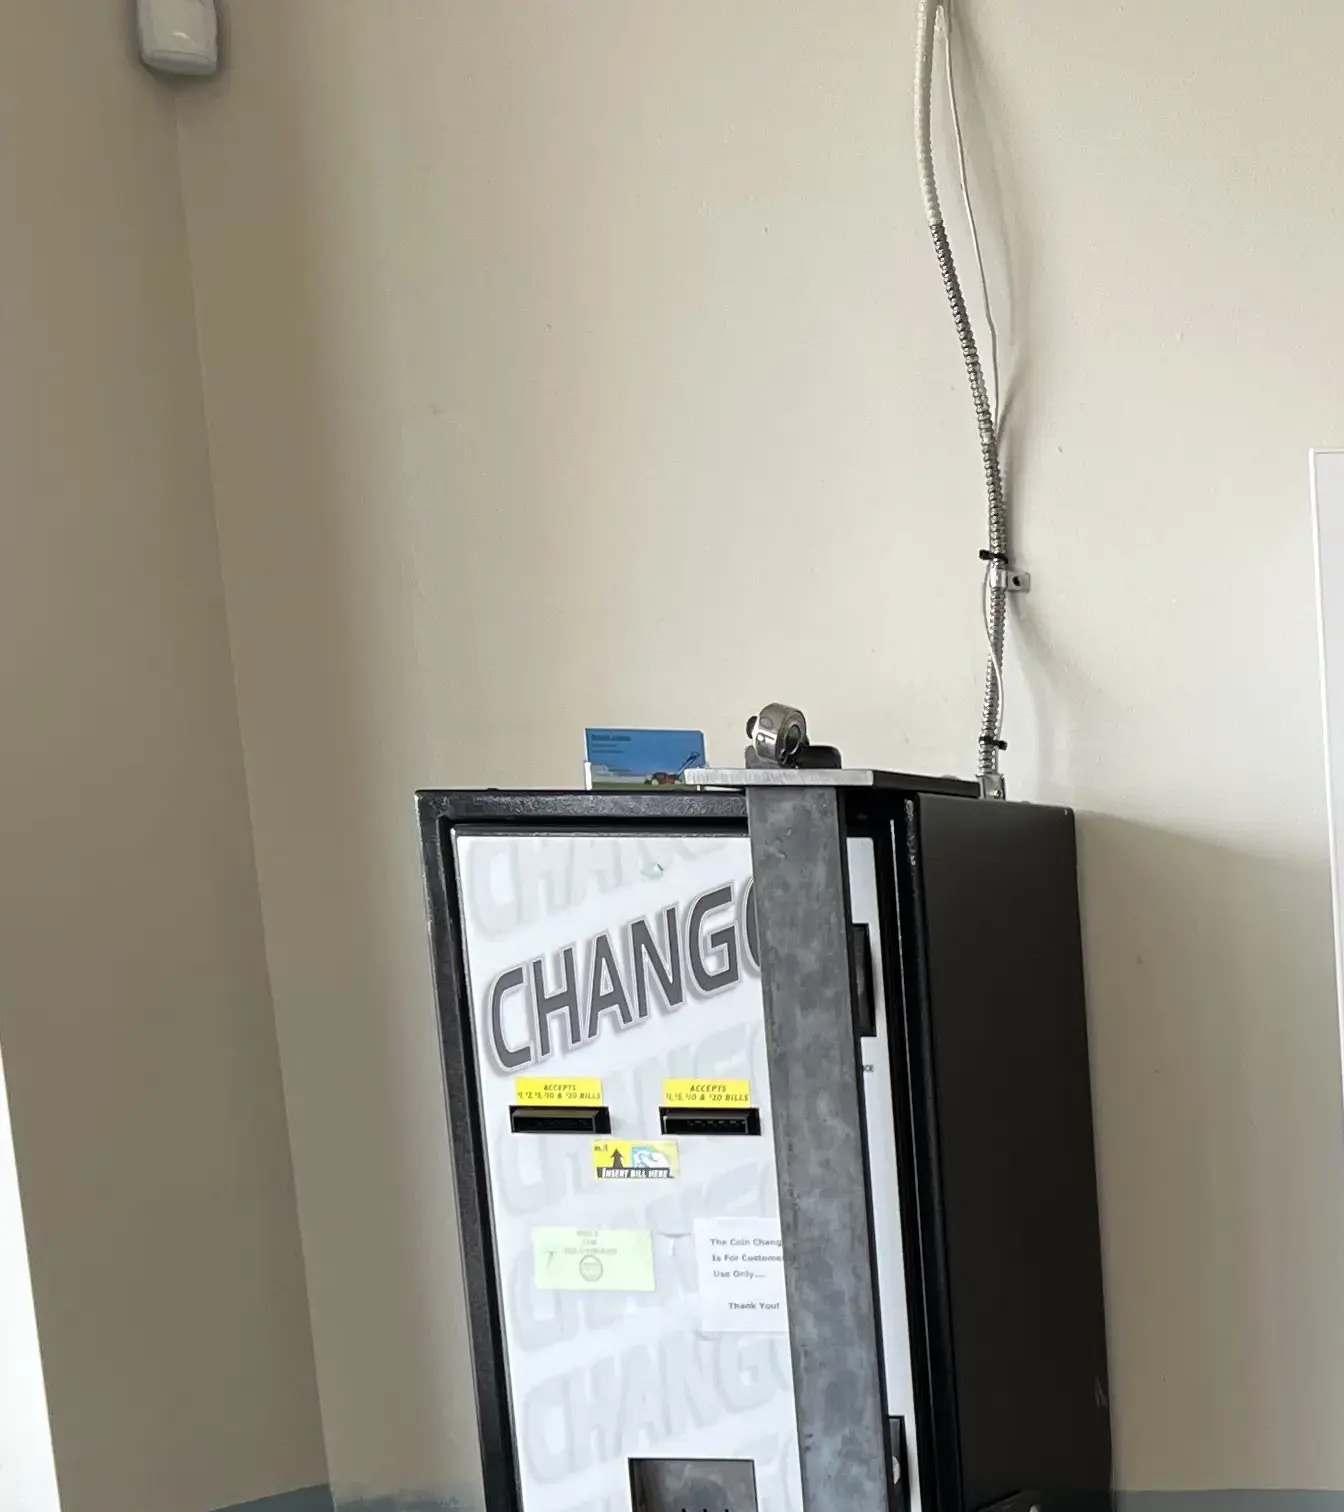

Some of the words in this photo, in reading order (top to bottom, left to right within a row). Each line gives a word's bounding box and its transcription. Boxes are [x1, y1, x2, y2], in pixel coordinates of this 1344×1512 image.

[490, 877, 760, 1071] CHANG
[543, 1083, 577, 1091] ACCEPTS
[689, 1084, 727, 1092] ACCEPTS
[579, 1092, 601, 1100] BILLS
[725, 1094, 749, 1102] BILLS
[602, 1167, 629, 1178] INSERT
[710, 1238, 727, 1246] The
[730, 1238, 750, 1246] Coin
[712, 1254, 721, 1262] Is
[724, 1254, 739, 1262] For
[713, 1270, 730, 1278] Use
[728, 1302, 757, 1310] Thank
[759, 1302, 780, 1310] You!
